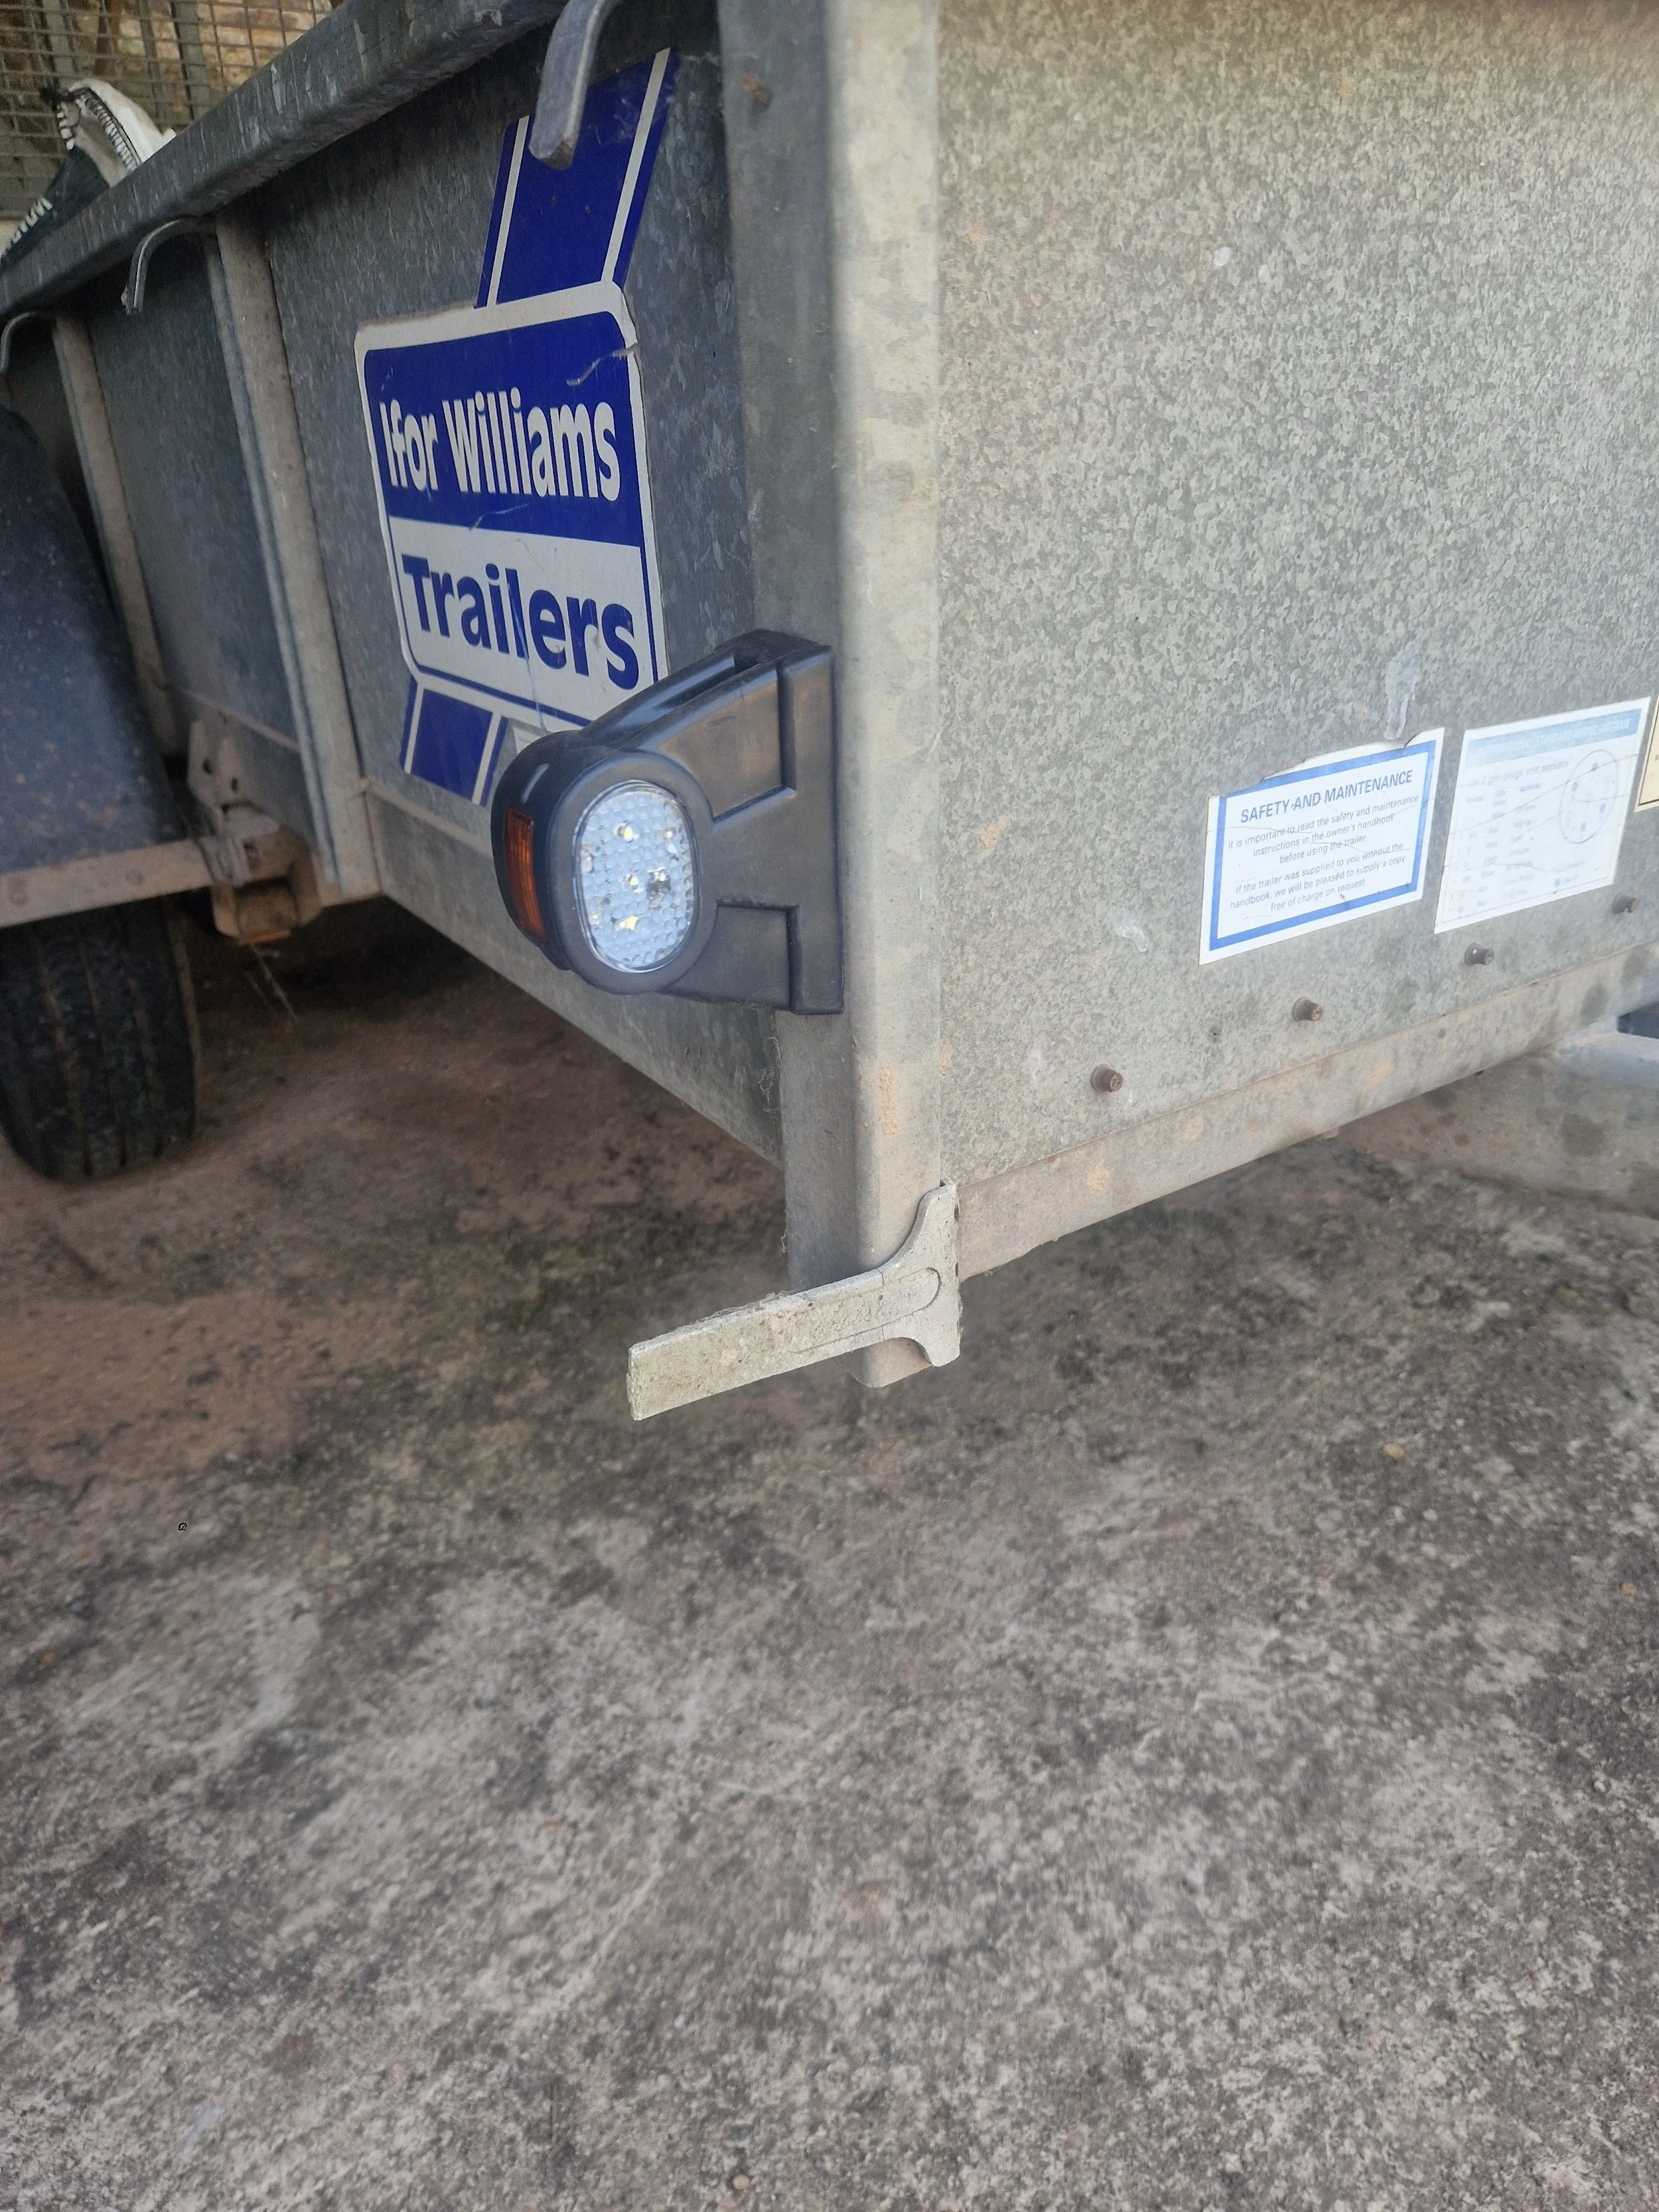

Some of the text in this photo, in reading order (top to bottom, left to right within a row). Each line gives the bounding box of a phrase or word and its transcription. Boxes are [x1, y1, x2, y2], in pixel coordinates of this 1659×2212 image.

[380, 387, 620, 501] Ifor Williams
[401, 554, 639, 690] Trailers
[1228, 840, 1234, 849] It
[1236, 838, 1243, 847] is
[1246, 828, 1285, 845] important
[1297, 820, 1315, 832] read
[1317, 817, 1329, 828] the
[1331, 811, 1354, 824] safety
[1356, 806, 1370, 817] and
[1372, 795, 1419, 812] maintenance
[1240, 770, 1413, 823] SAFETY AND MAINTENANCE
[1254, 814, 1394, 857] instructions in the owner's handbook
[1279, 834, 1367, 864] before using the trailer
[1230, 893, 1272, 909] handbook,
[1275, 887, 1285, 897] we
[1288, 882, 1302, 895] will
[1304, 879, 1313, 889] be
[1315, 872, 1344, 888] pleased
[1346, 868, 1354, 877] to
[1356, 862, 1380, 875] supply
[1389, 855, 1406, 868] copy
[1236, 884, 1243, 894] If
[1244, 882, 1256, 893] the
[1259, 875, 1281, 888] trailer
[1284, 871, 1300, 881] was
[1302, 861, 1334, 879] supplied
[1346, 855, 1360, 867] you
[1362, 847, 1390, 860] without
[1392, 842, 1404, 852] the
[1271, 879, 1366, 911] free of charge on request
